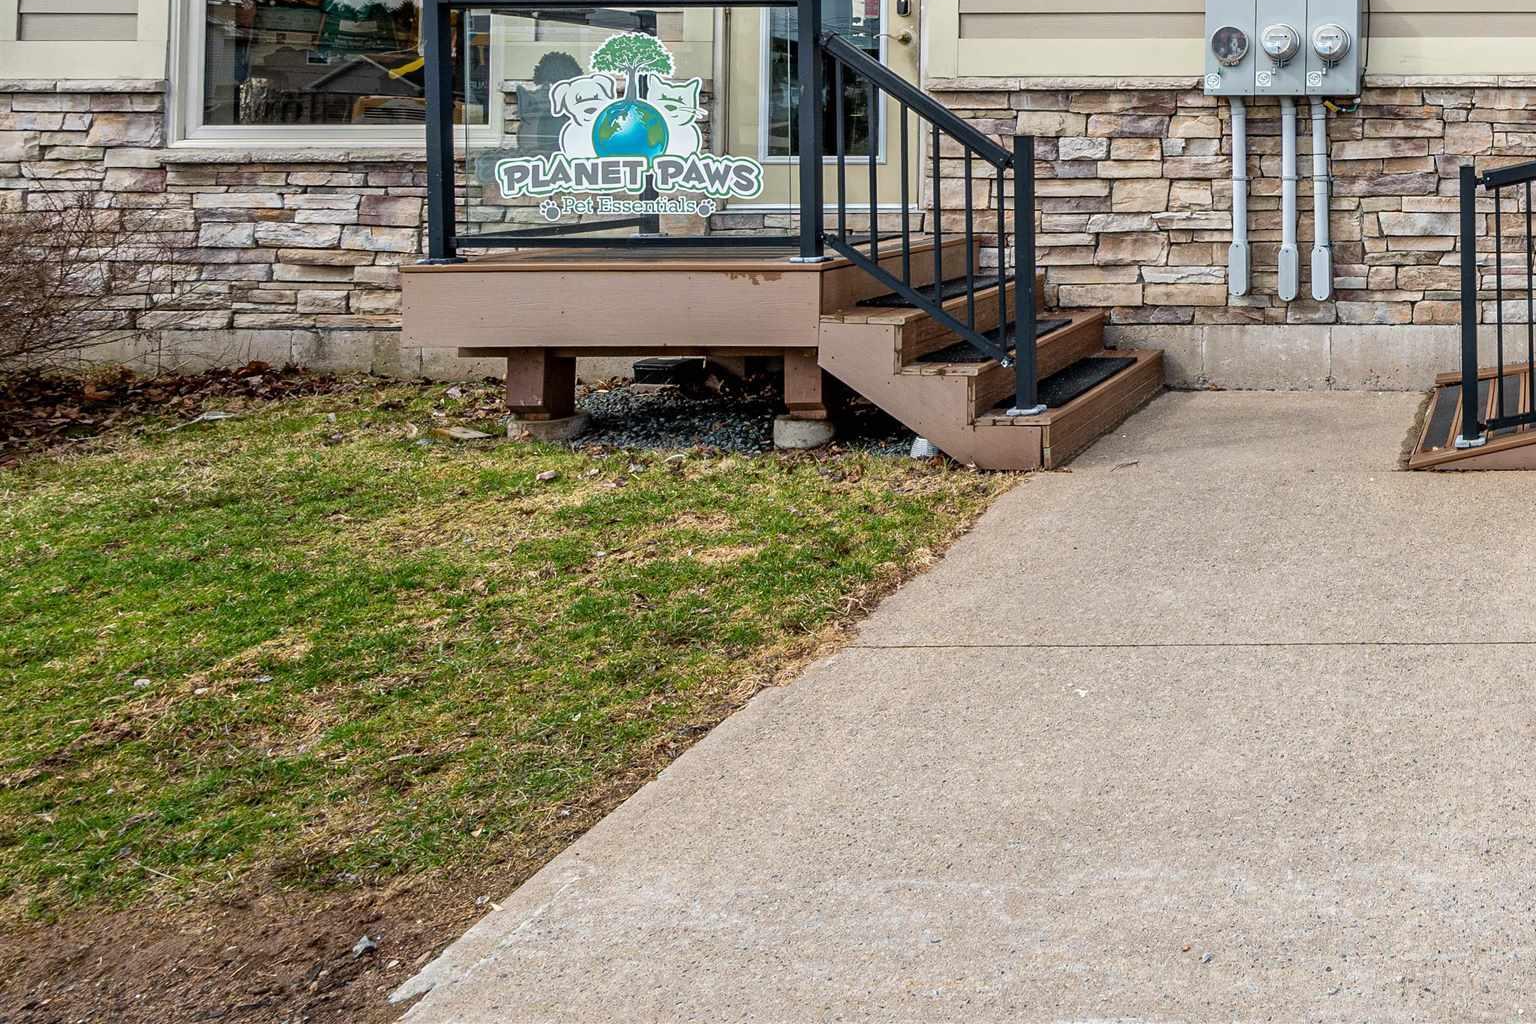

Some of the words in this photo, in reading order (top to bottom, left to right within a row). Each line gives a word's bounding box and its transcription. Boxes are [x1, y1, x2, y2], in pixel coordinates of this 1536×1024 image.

[503, 156, 645, 193] PLANET
[654, 155, 758, 193] PAWS
[563, 197, 593, 213] Pet
[598, 197, 696, 213] Essentials
